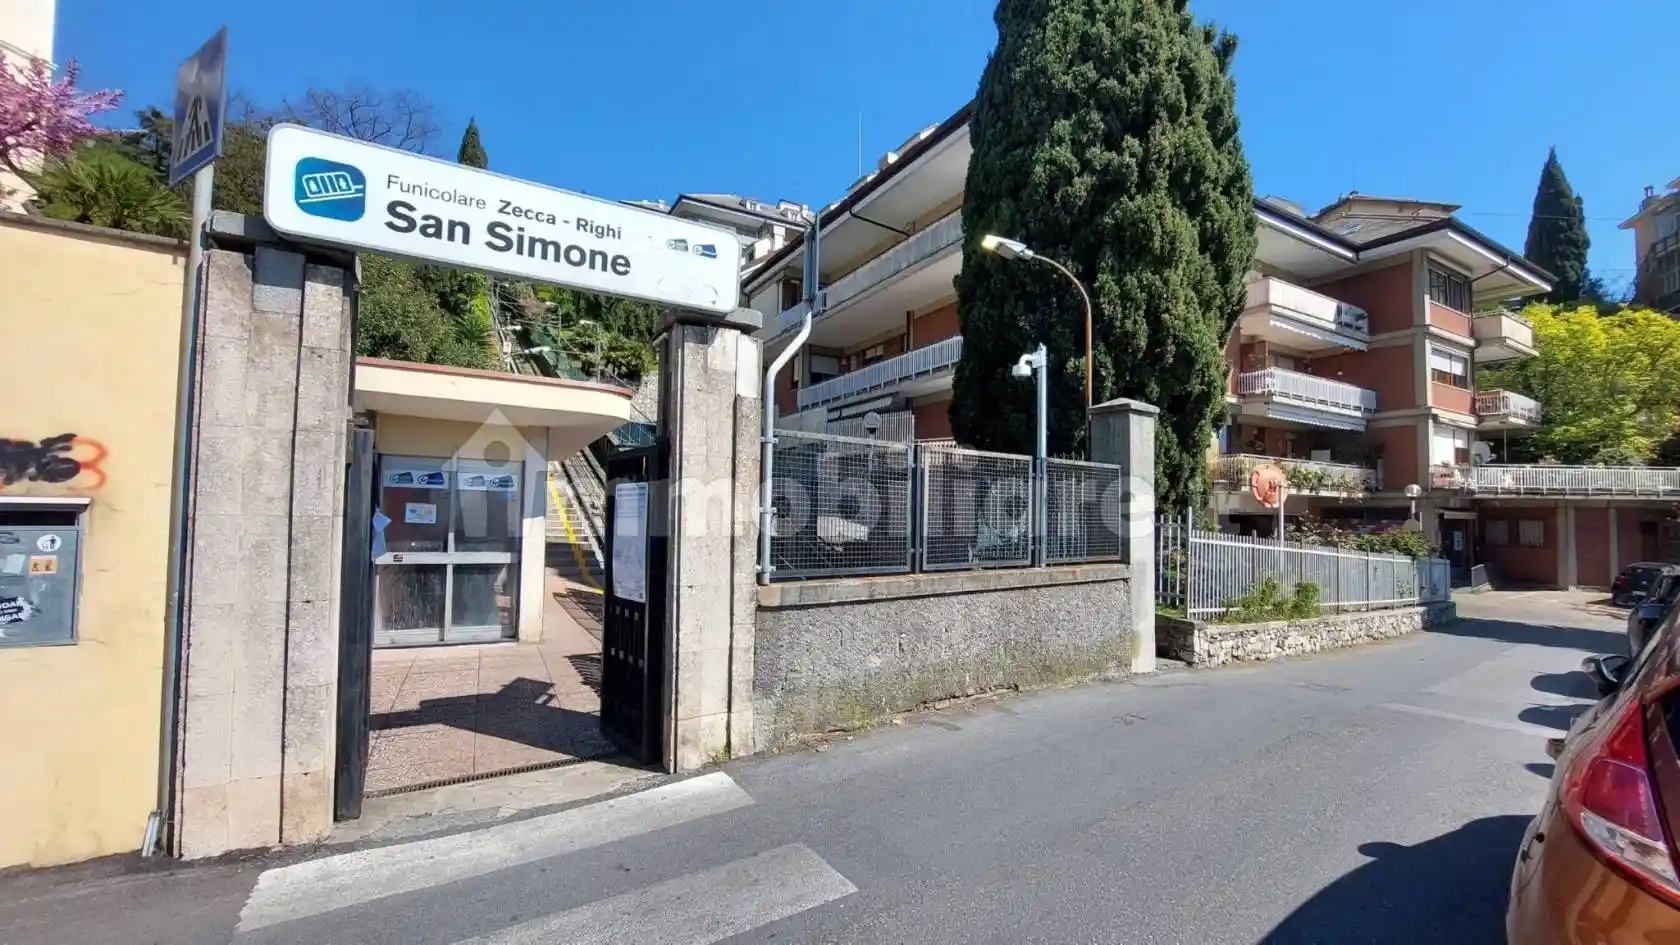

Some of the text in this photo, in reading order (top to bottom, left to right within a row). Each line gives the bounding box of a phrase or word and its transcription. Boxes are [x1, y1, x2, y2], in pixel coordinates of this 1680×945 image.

[384, 199, 632, 276] San Simone
[387, 173, 487, 210] Funicolare
[497, 199, 557, 225] Zecca
[576, 216, 623, 240] Righi
